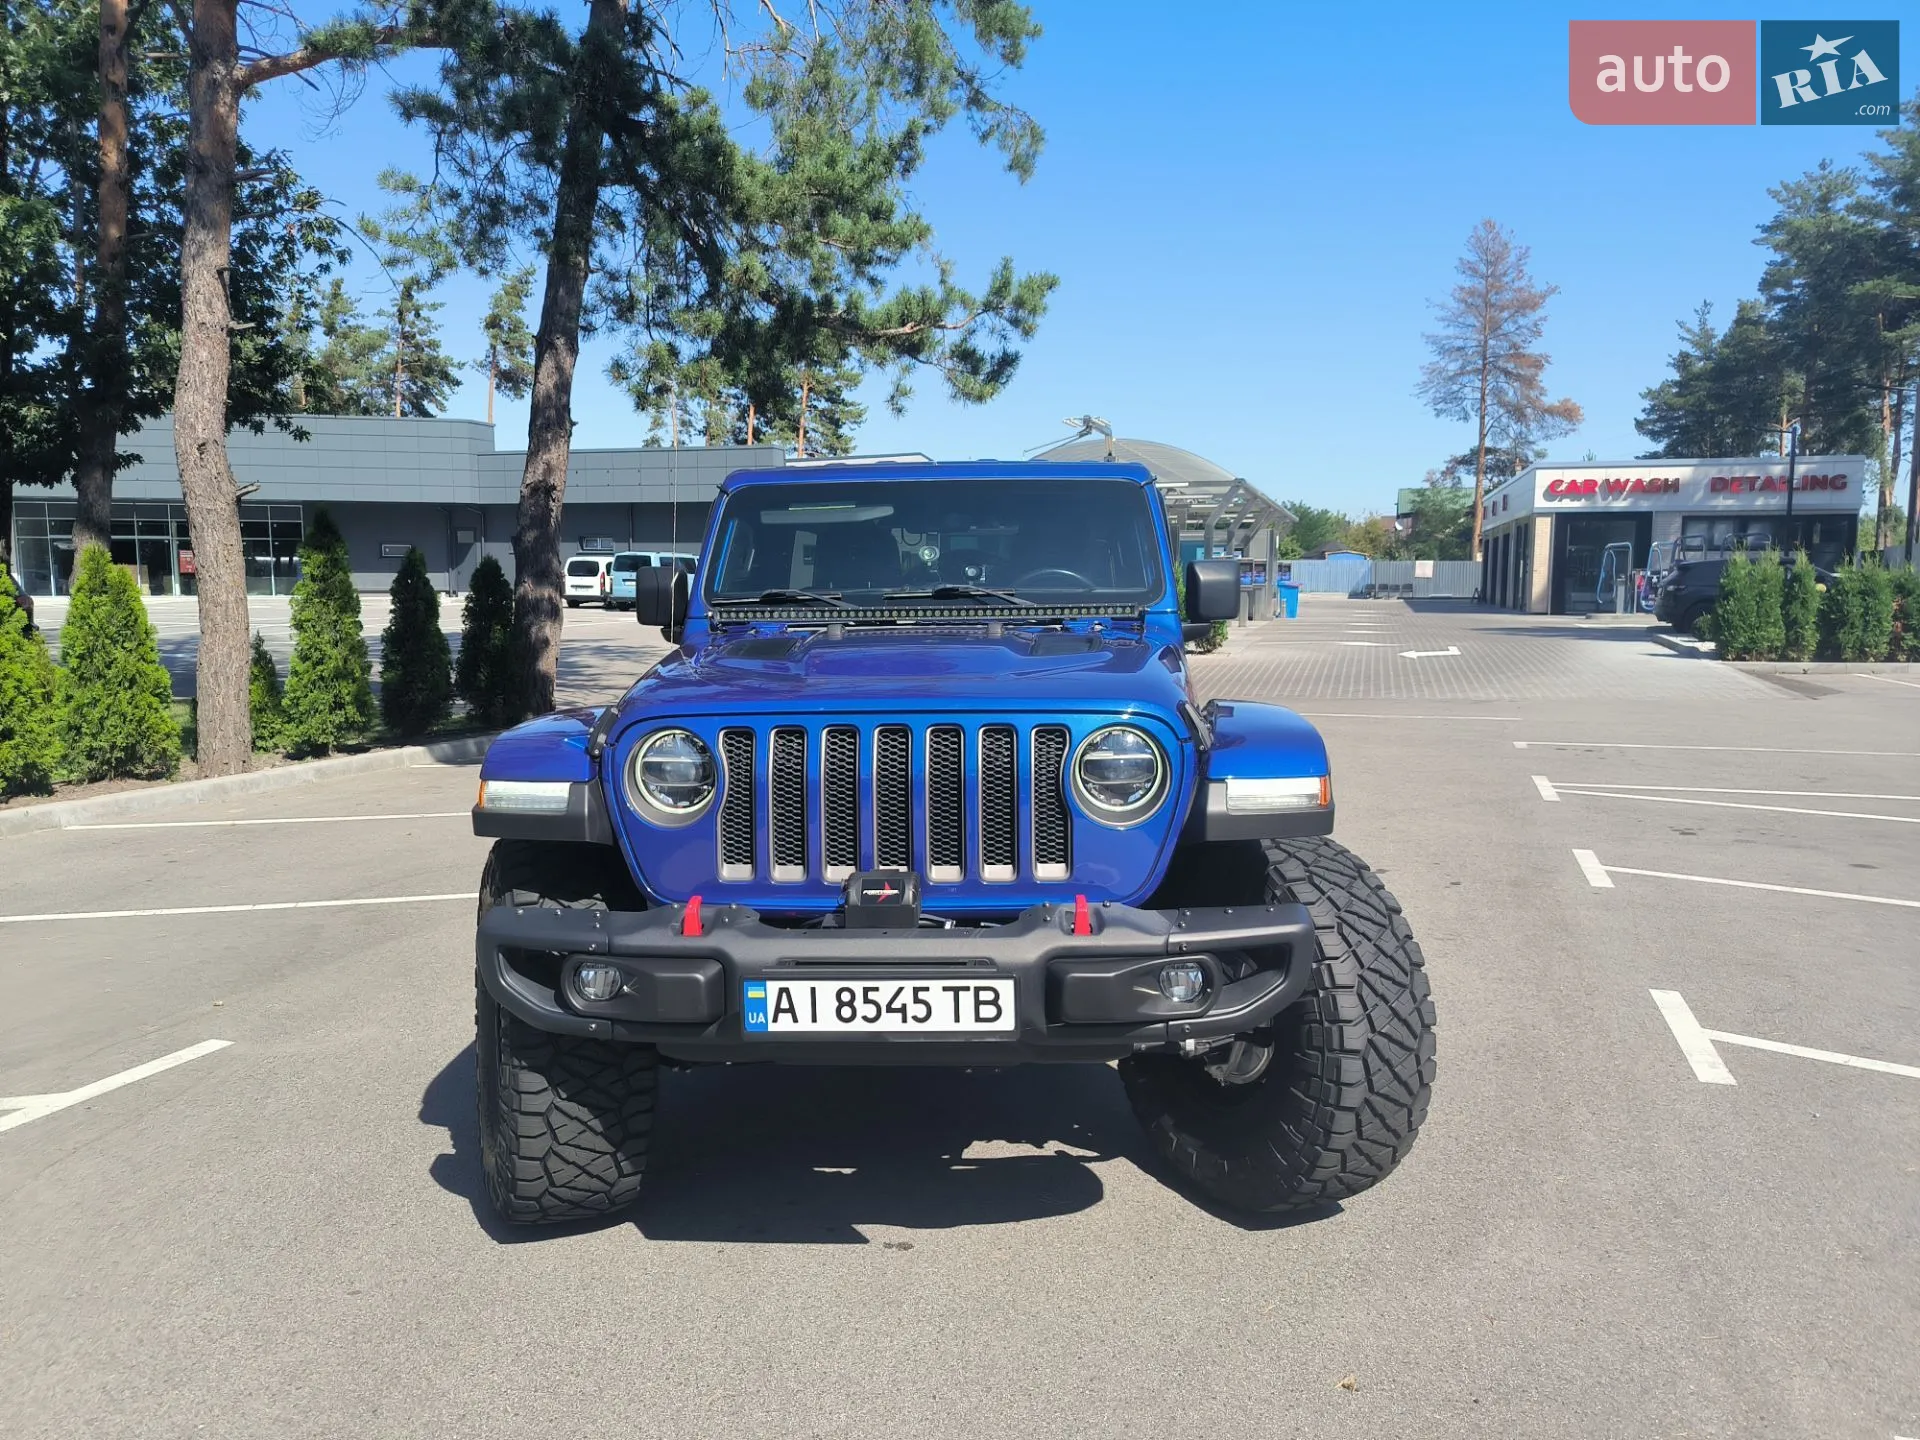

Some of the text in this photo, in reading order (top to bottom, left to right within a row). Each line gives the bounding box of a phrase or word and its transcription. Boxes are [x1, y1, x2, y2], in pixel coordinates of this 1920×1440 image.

[1548, 477, 1680, 496] CAR WASH
[772, 986, 1003, 1024] AI 8545 TB
[748, 1012, 766, 1024] UA
